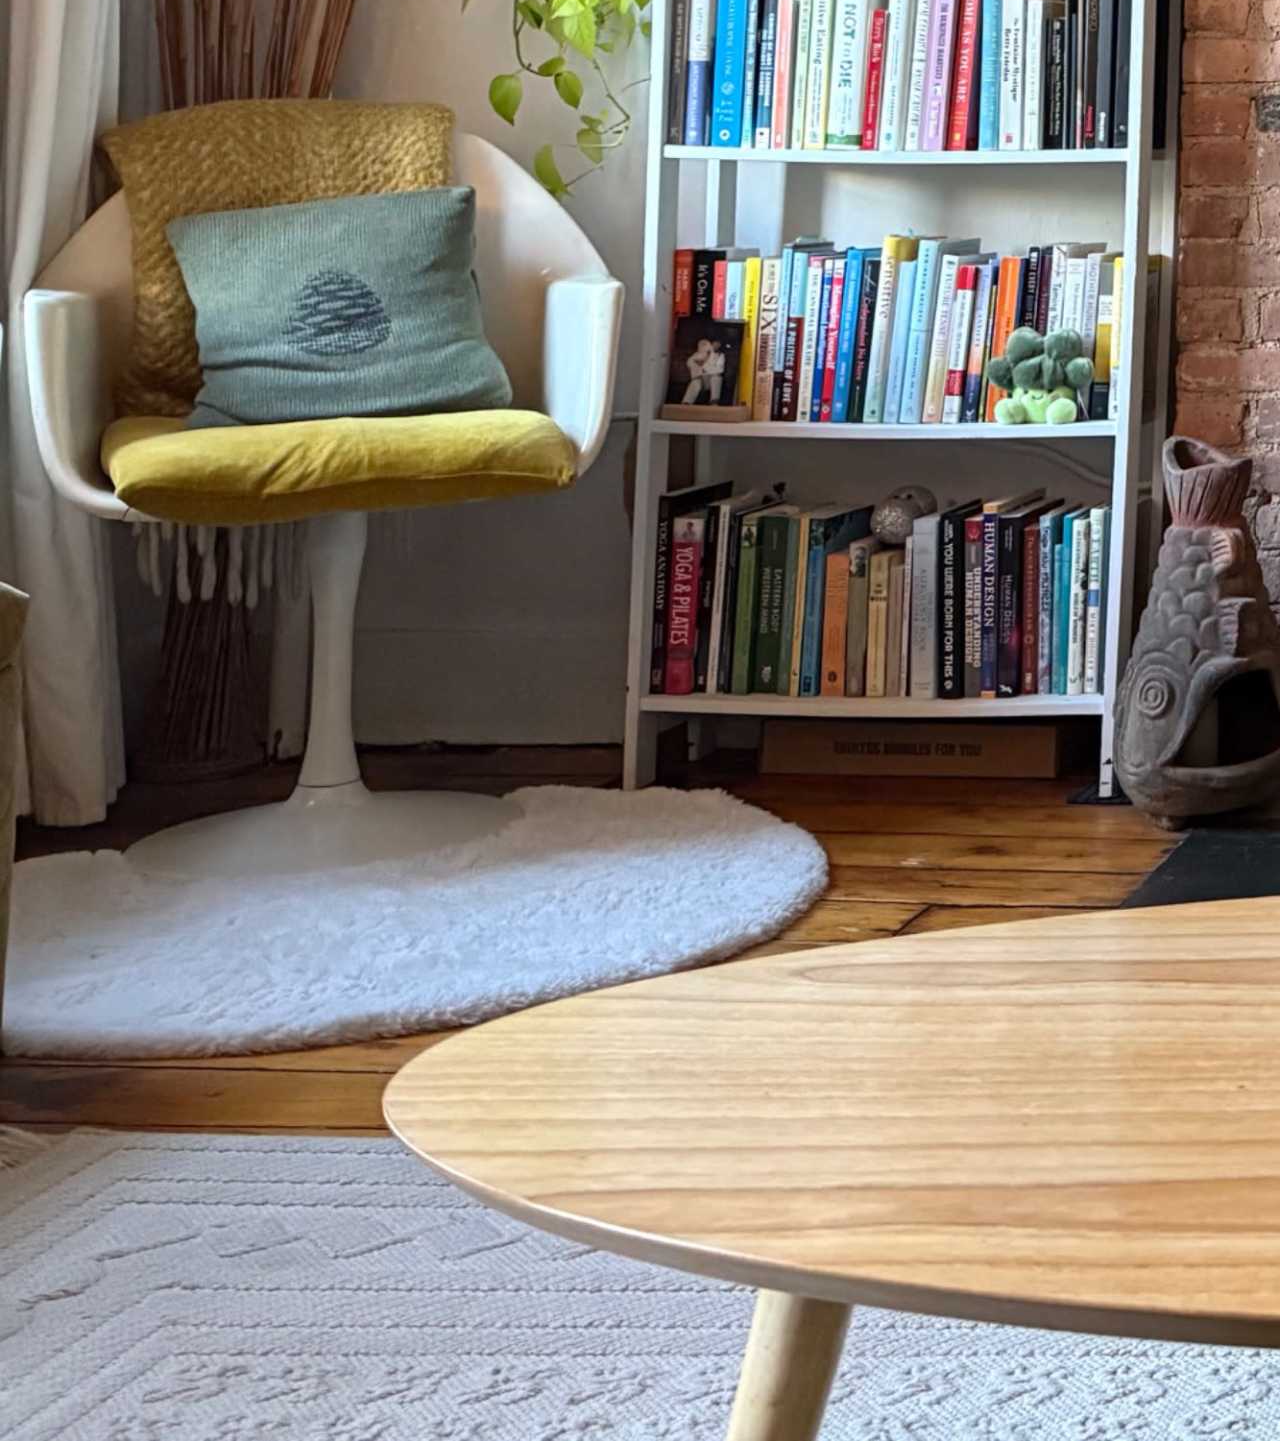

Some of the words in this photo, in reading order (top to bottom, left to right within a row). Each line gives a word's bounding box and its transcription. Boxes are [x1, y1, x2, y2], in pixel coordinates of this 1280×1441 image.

[842, 3, 857, 39] NOT
[813, 29, 825, 64] Eating
[959, 47, 971, 72] YOU
[838, 60, 852, 87] DIE
[956, 78, 968, 102] ARE
[697, 264, 708, 277] It's
[696, 280, 708, 294] On
[1049, 282, 1061, 311] Taming
[696, 297, 707, 312] Me
[760, 294, 778, 331] SIX
[785, 332, 796, 366] POLITICS
[784, 369, 792, 379] OF
[782, 382, 792, 402] LOVE
[657, 520, 667, 552] YOGA
[983, 522, 995, 573] HUMAN
[674, 546, 694, 580] YOGA
[943, 542, 953, 564] YOU
[655, 556, 666, 610] ANATOMY
[675, 583, 691, 592] &
[943, 567, 953, 594] WERE
[965, 571, 973, 611] HUMAN
[943, 598, 953, 628] BORN
[983, 576, 994, 626] DESIGN
[668, 596, 691, 644] PILATES
[971, 567, 982, 667] UNDERSTANDING
[943, 630, 953, 651] FOR
[964, 614, 973, 663] DESIGN
[943, 654, 953, 676] THIS
